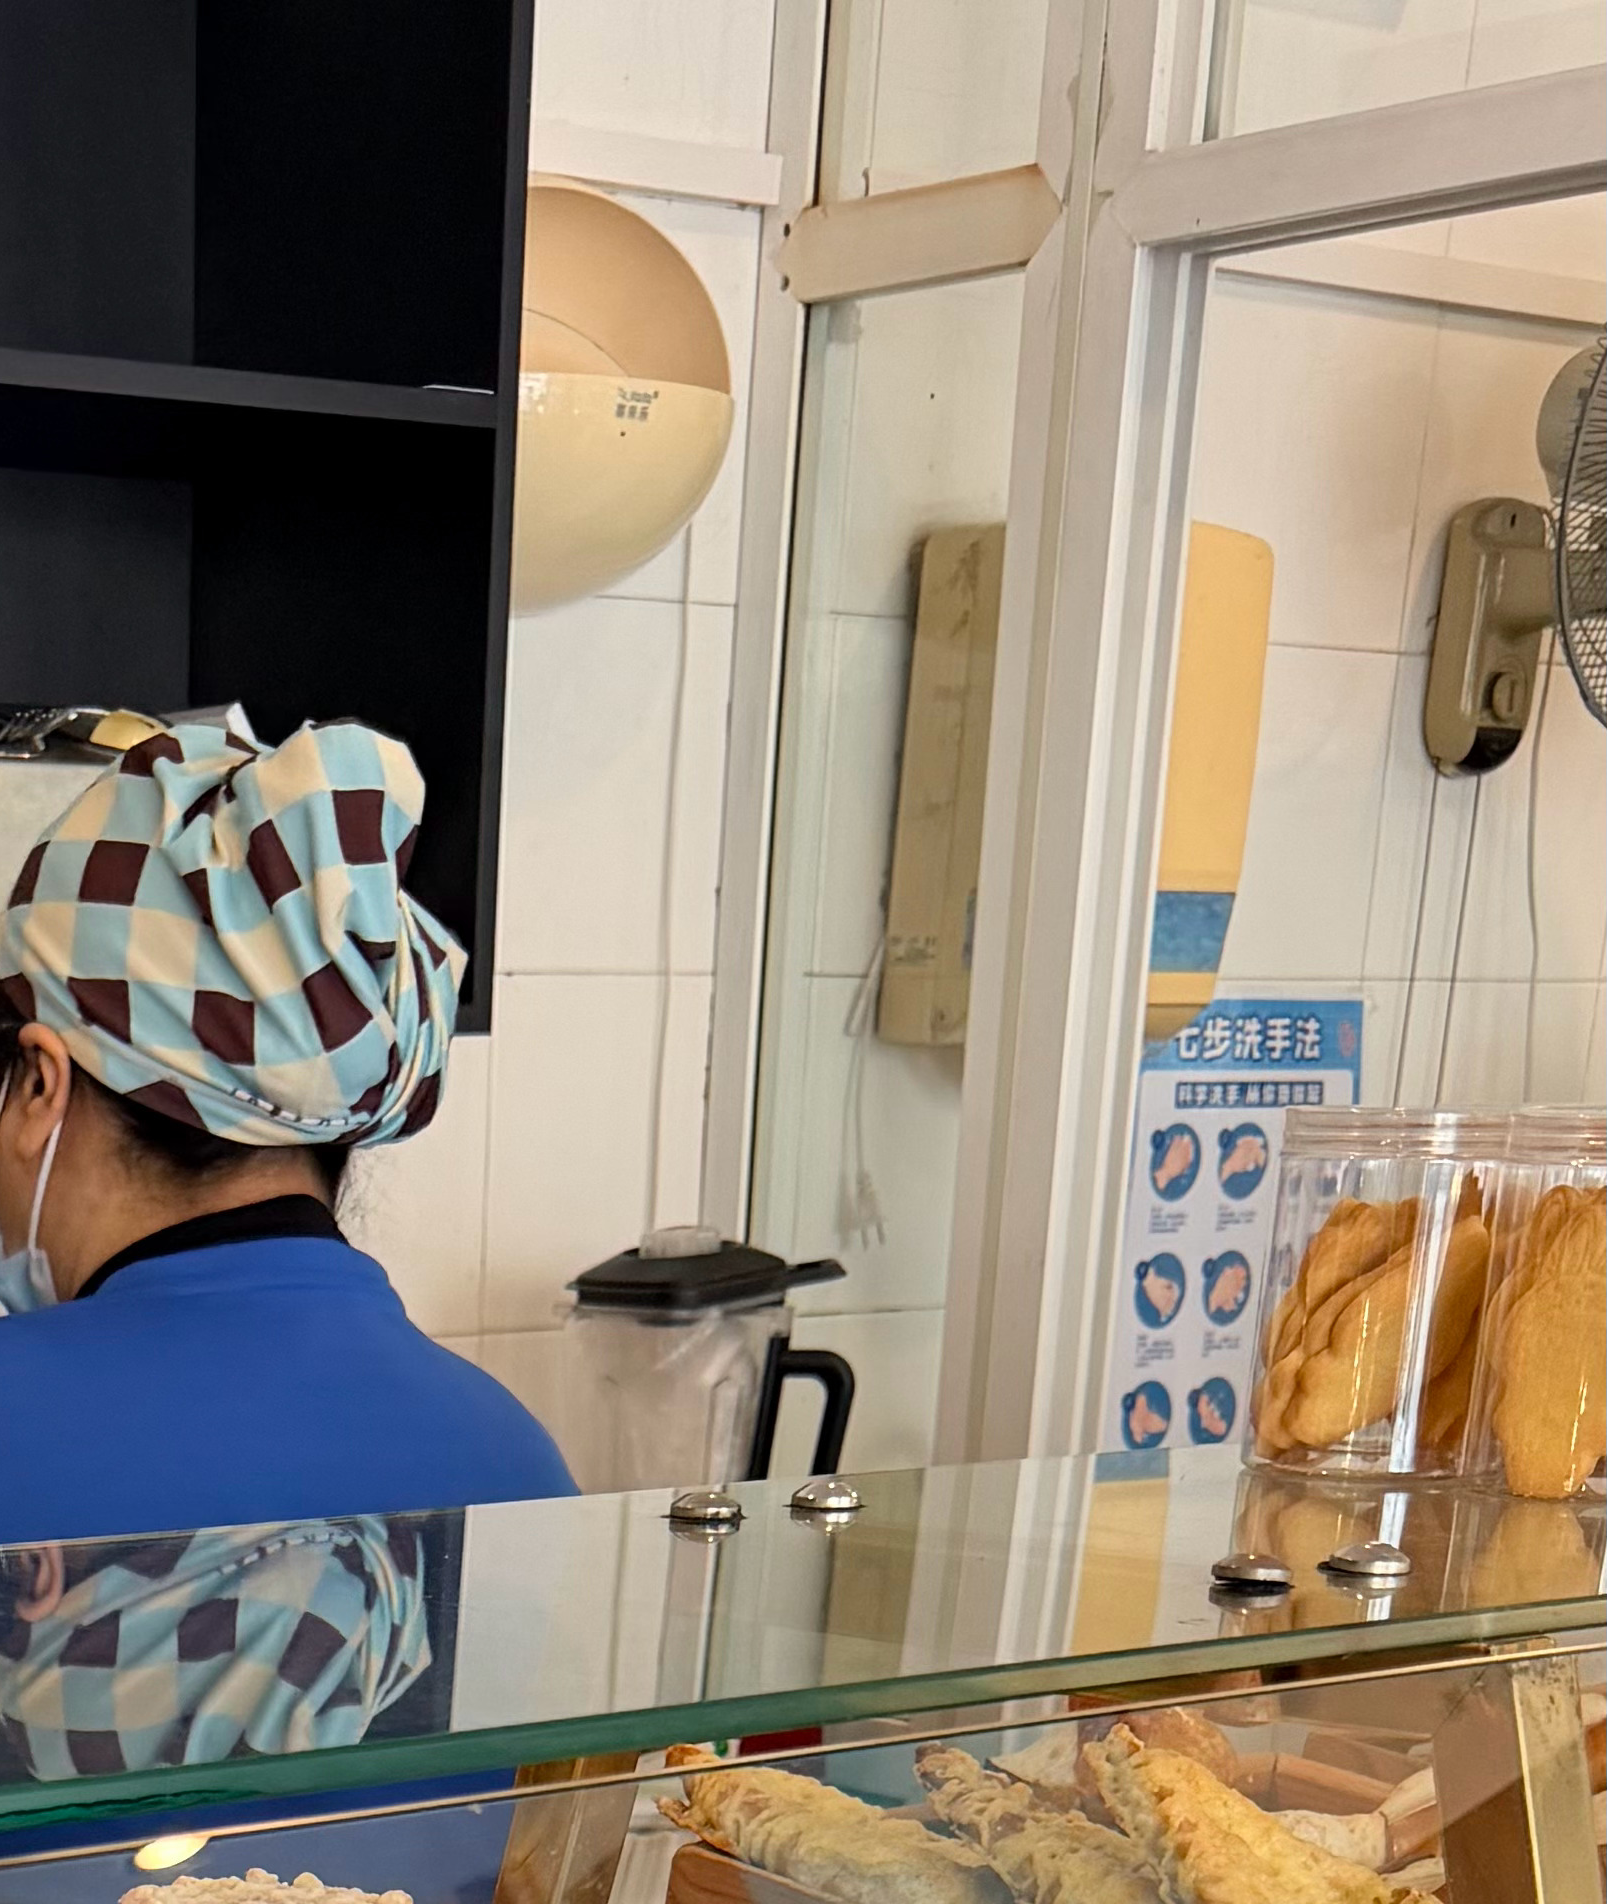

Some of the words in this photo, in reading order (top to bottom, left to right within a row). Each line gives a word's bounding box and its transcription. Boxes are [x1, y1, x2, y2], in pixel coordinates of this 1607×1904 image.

[1176, 1017, 1322, 1060] 七步洗手法
